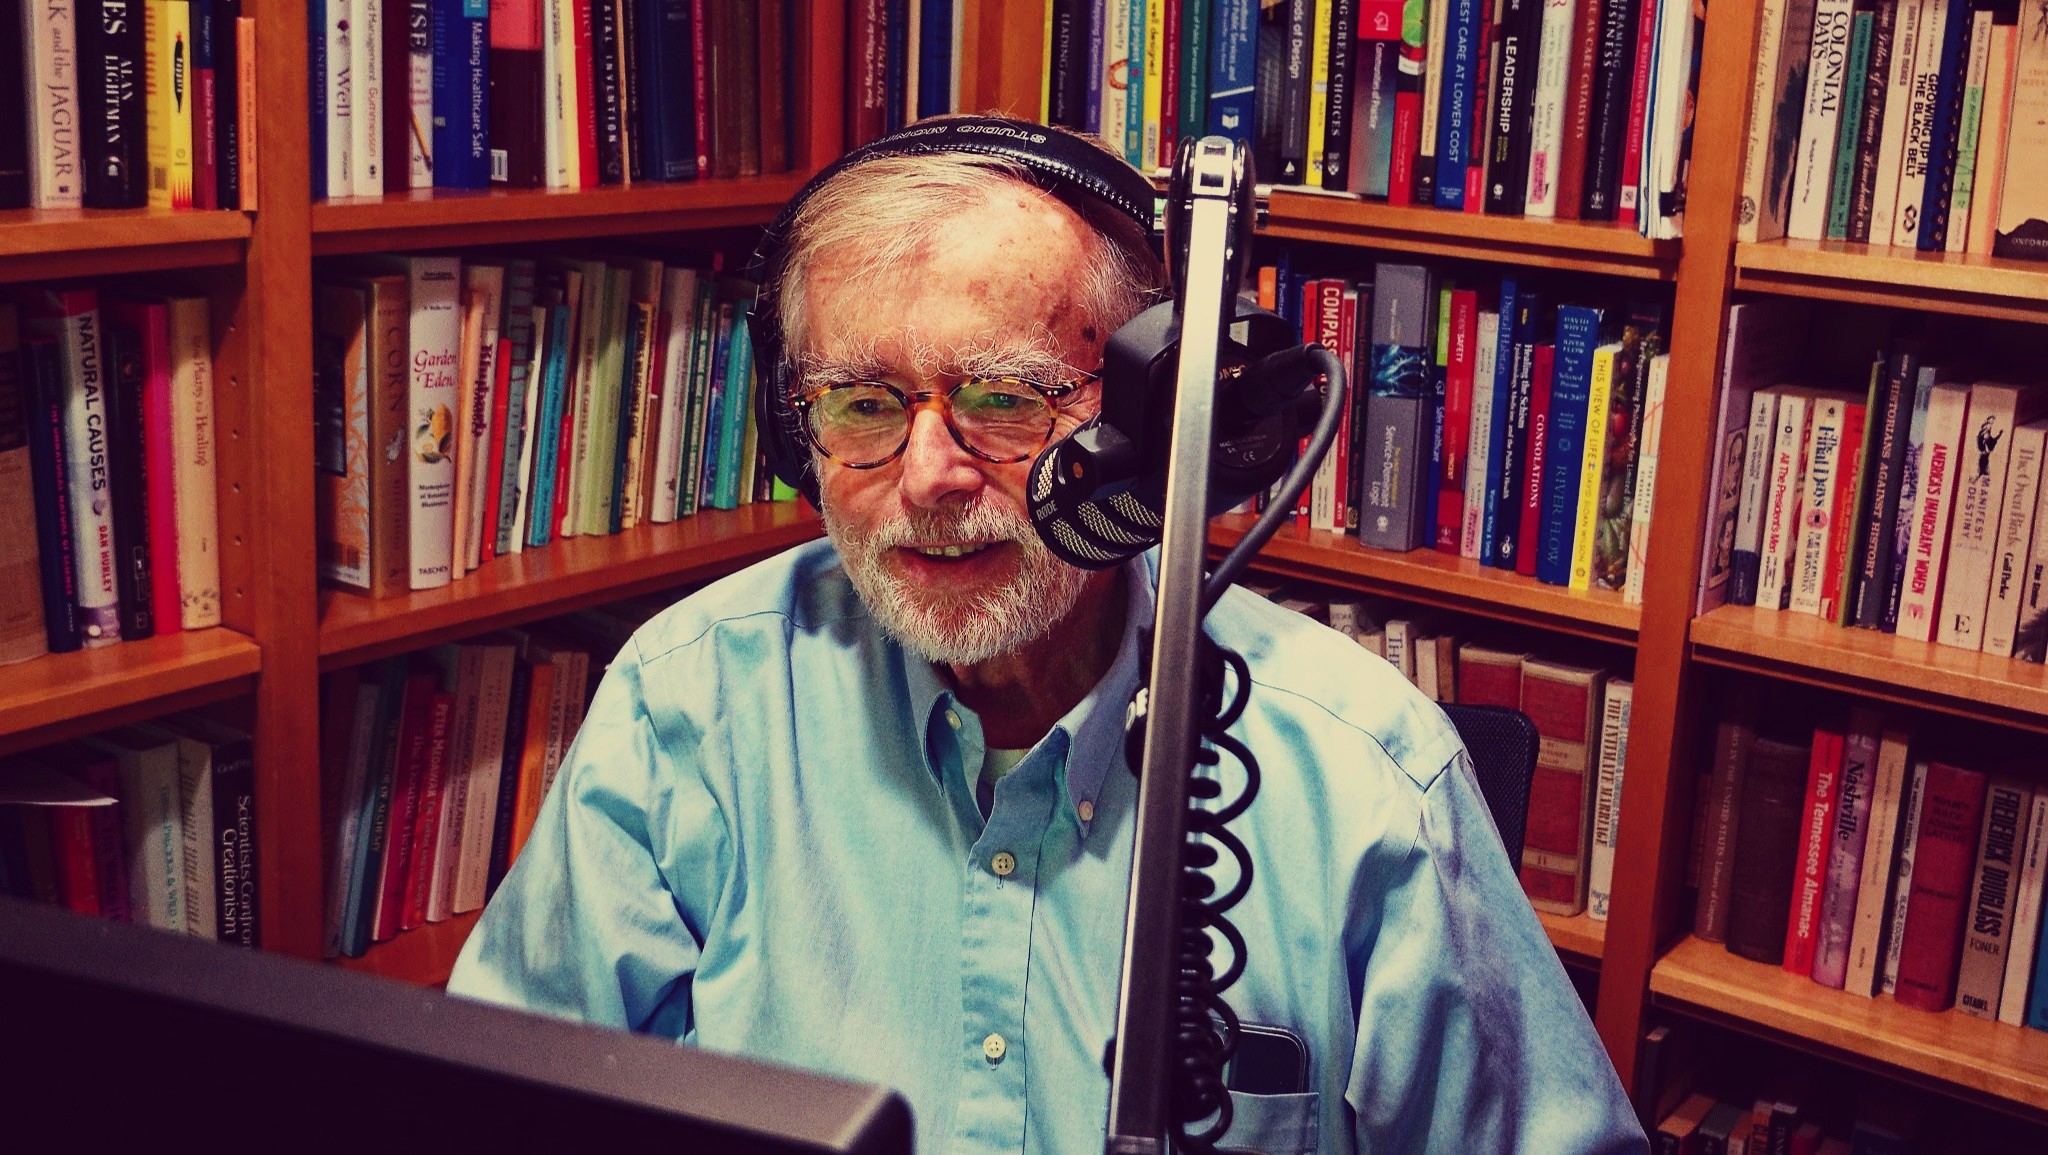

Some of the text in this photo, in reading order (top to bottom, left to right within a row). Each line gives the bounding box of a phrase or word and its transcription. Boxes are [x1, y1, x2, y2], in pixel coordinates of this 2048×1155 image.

[1059, 13, 1071, 68] LEADING
[1147, 2, 1160, 77] well designed
[1288, 23, 1304, 80] of Design
[1455, 27, 1470, 61] CARE
[1812, 11, 1833, 60] DAYS
[120, 60, 133, 101] ALAN
[469, 22, 484, 159] Making Healthcare Safe
[1330, 21, 1349, 137] GREAT CHOICES
[1455, 64, 1466, 80] AT
[1499, 36, 1518, 133] LEADERSHIP
[1575, 20, 1596, 139] AS CARE CATALYSTS
[1820, 11, 1850, 117] COLONIAL
[48, 28, 74, 178] and the JAGUAR
[104, 55, 121, 143] LIGHTMAN
[336, 67, 351, 118] Well
[606, 56, 618, 143] INVENTION
[1450, 83, 1464, 128] LOWER
[1920, 73, 1940, 137] GROWING
[955, 125, 1047, 144] STUDIO
[1448, 130, 1461, 163] COST
[1905, 73, 1928, 179] THE BLACK BELT
[1918, 141, 1931, 158] UP
[1915, 162, 1929, 176] IN
[1516, 343, 1533, 429] Healing the Schism
[1594, 358, 1607, 383] THIS
[79, 315, 106, 492] NATURAL CAUSES
[1590, 420, 1602, 436] OF
[1591, 386, 1605, 417] VIEW
[1627, 403, 1642, 448] Philosophy
[193, 415, 209, 467] Healing
[1432, 405, 1445, 463] Safer Healthcare
[1528, 413, 1545, 509] CONSOLATIONS
[1587, 438, 1599, 460] LIFE
[1626, 449, 1636, 462] for
[1813, 425, 1836, 464] Final
[1826, 435, 1839, 455] The
[2018, 447, 2036, 471] The
[1379, 424, 1397, 508] Service-Dominant
[1502, 477, 1511, 499] Health
[1503, 450, 1513, 476] Public's
[1584, 471, 1596, 497] DAVID
[1623, 463, 1635, 495] Limited
[1812, 468, 1830, 507] Days
[1863, 378, 1902, 579] HISTORIANS AGAINST HISTORY
[1369, 480, 1381, 506] Logic
[1546, 464, 1568, 565] RIVER FLOW
[1768, 452, 1790, 553] All The President's Men
[1910, 442, 1948, 595] AMERICA'S IMMIGRANT WOMEN
[1961, 485, 1977, 540] DESTINY
[1973, 477, 1991, 542] MANIFEST
[98, 524, 113, 593] DAN HURLEY
[1578, 526, 1591, 562] WILSON
[1997, 571, 2013, 600] Parker
[1606, 698, 1621, 721] THE
[426, 703, 449, 797] PETER MEDAWAR
[1601, 723, 1619, 784] INTIMATE
[404, 763, 422, 819] Double
[1594, 786, 1613, 847] MARRIAGE
[1836, 759, 1865, 841] Nashville
[222, 827, 240, 935] Creationism
[237, 795, 256, 949] Scientists Confron
[1796, 771, 1833, 939] The Tennessee Almanac
[1972, 788, 2022, 938] FREDERICK DOUGLASS
[1969, 937, 2001, 955] FONER
